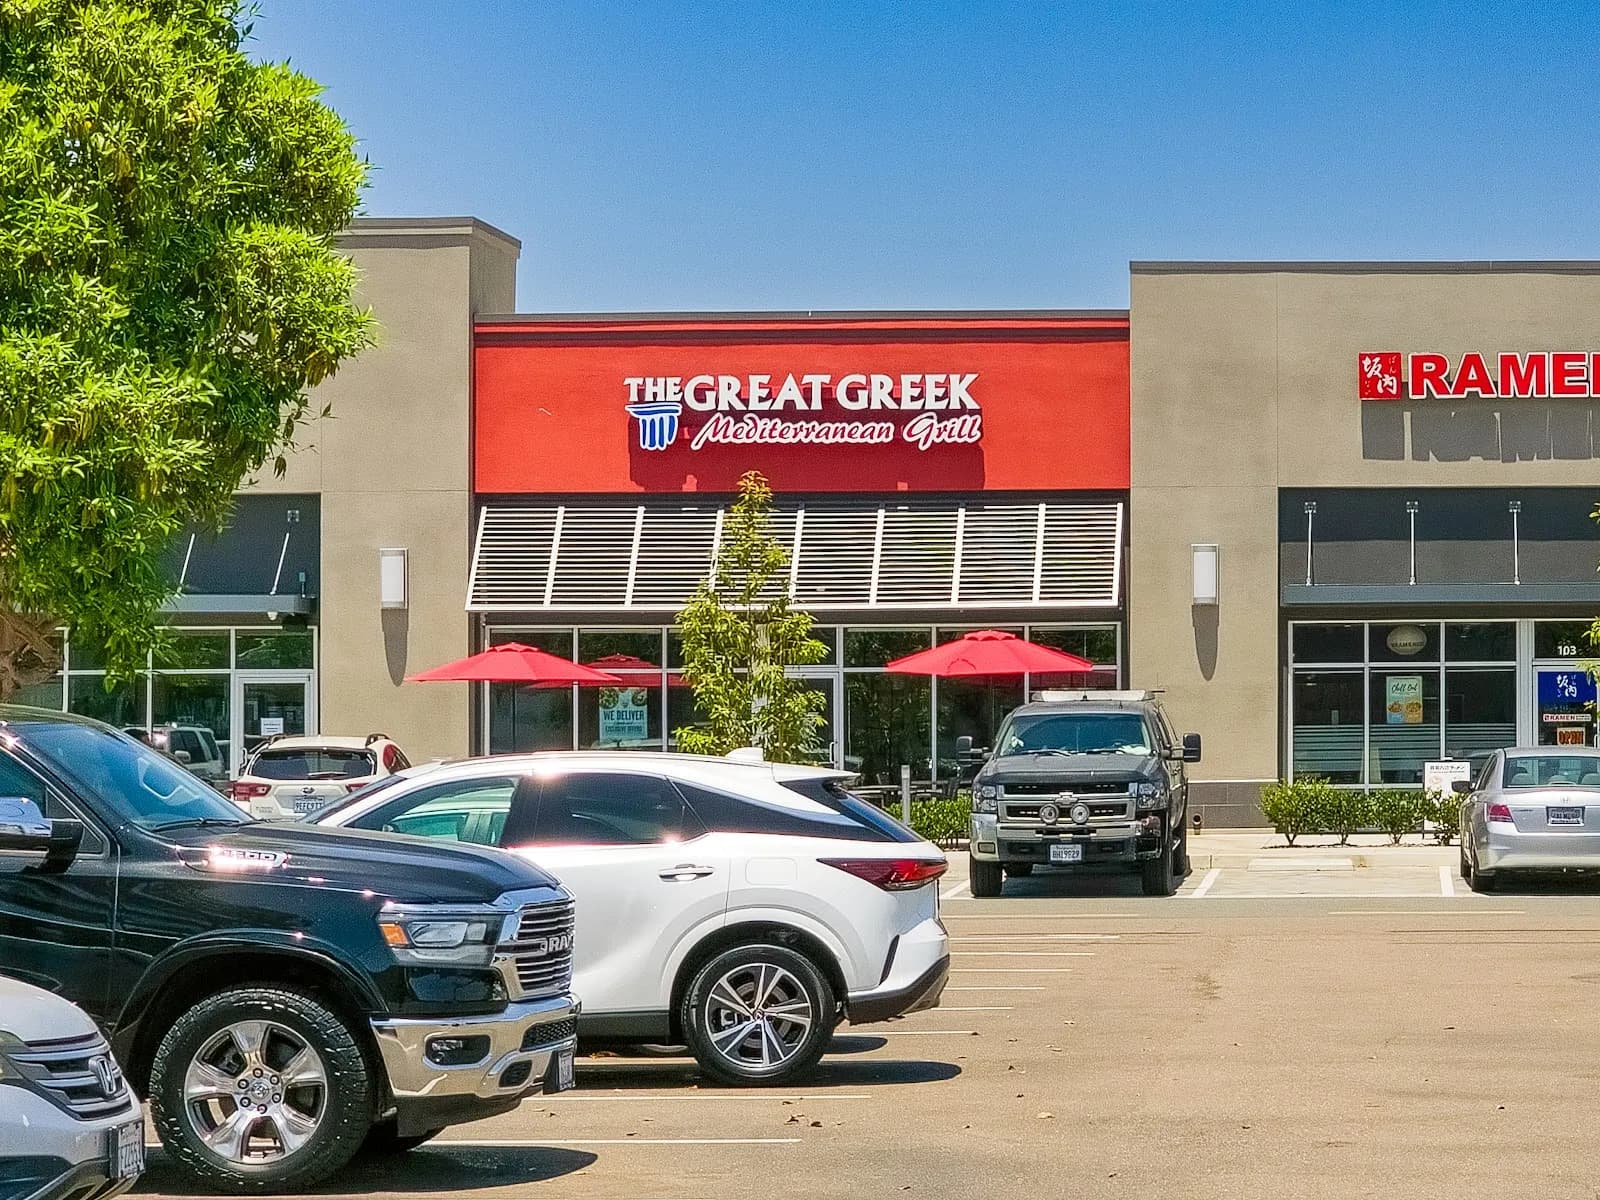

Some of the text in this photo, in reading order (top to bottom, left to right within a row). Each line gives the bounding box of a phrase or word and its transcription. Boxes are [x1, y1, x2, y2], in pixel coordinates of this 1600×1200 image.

[623, 373, 982, 411] THE GREAT GREEK
[1408, 351, 1600, 399] RAME
[690, 411, 983, 451] Mediterranean Grill
[1557, 645, 1577, 657] 103
[603, 710, 645, 720] WE DELIVER
